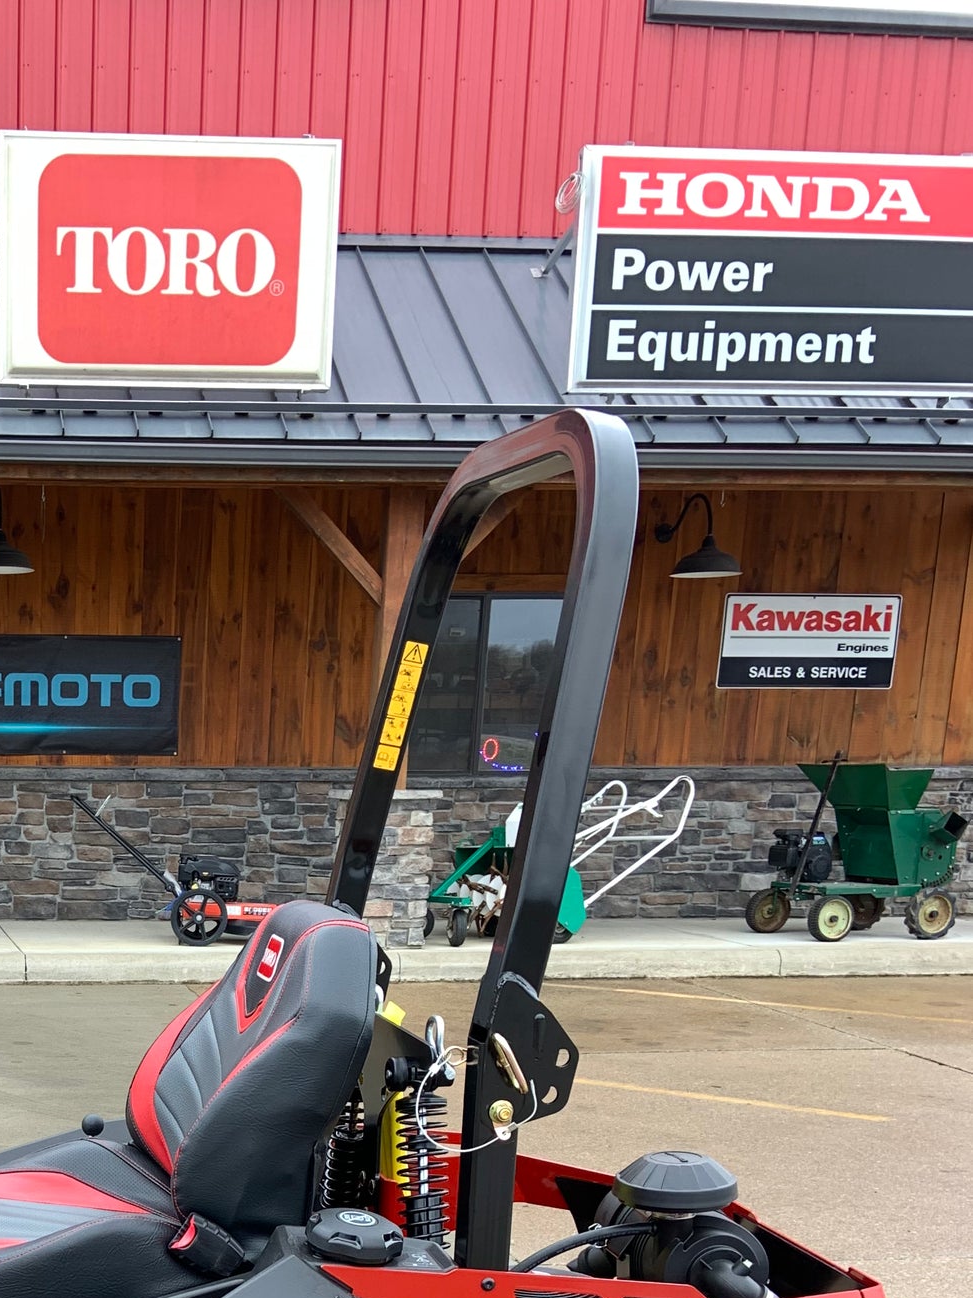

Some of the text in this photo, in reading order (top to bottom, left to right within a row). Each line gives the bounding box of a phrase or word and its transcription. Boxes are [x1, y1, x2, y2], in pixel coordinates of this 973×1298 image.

[617, 171, 931, 223] HONDA
[56, 226, 276, 297] TORO
[611, 247, 774, 292] Power
[606, 319, 877, 372] Equipment
[731, 603, 893, 633] Kawasaki
[837, 643, 889, 654] Engines
[749, 666, 868, 679] SALES & SERVICE
